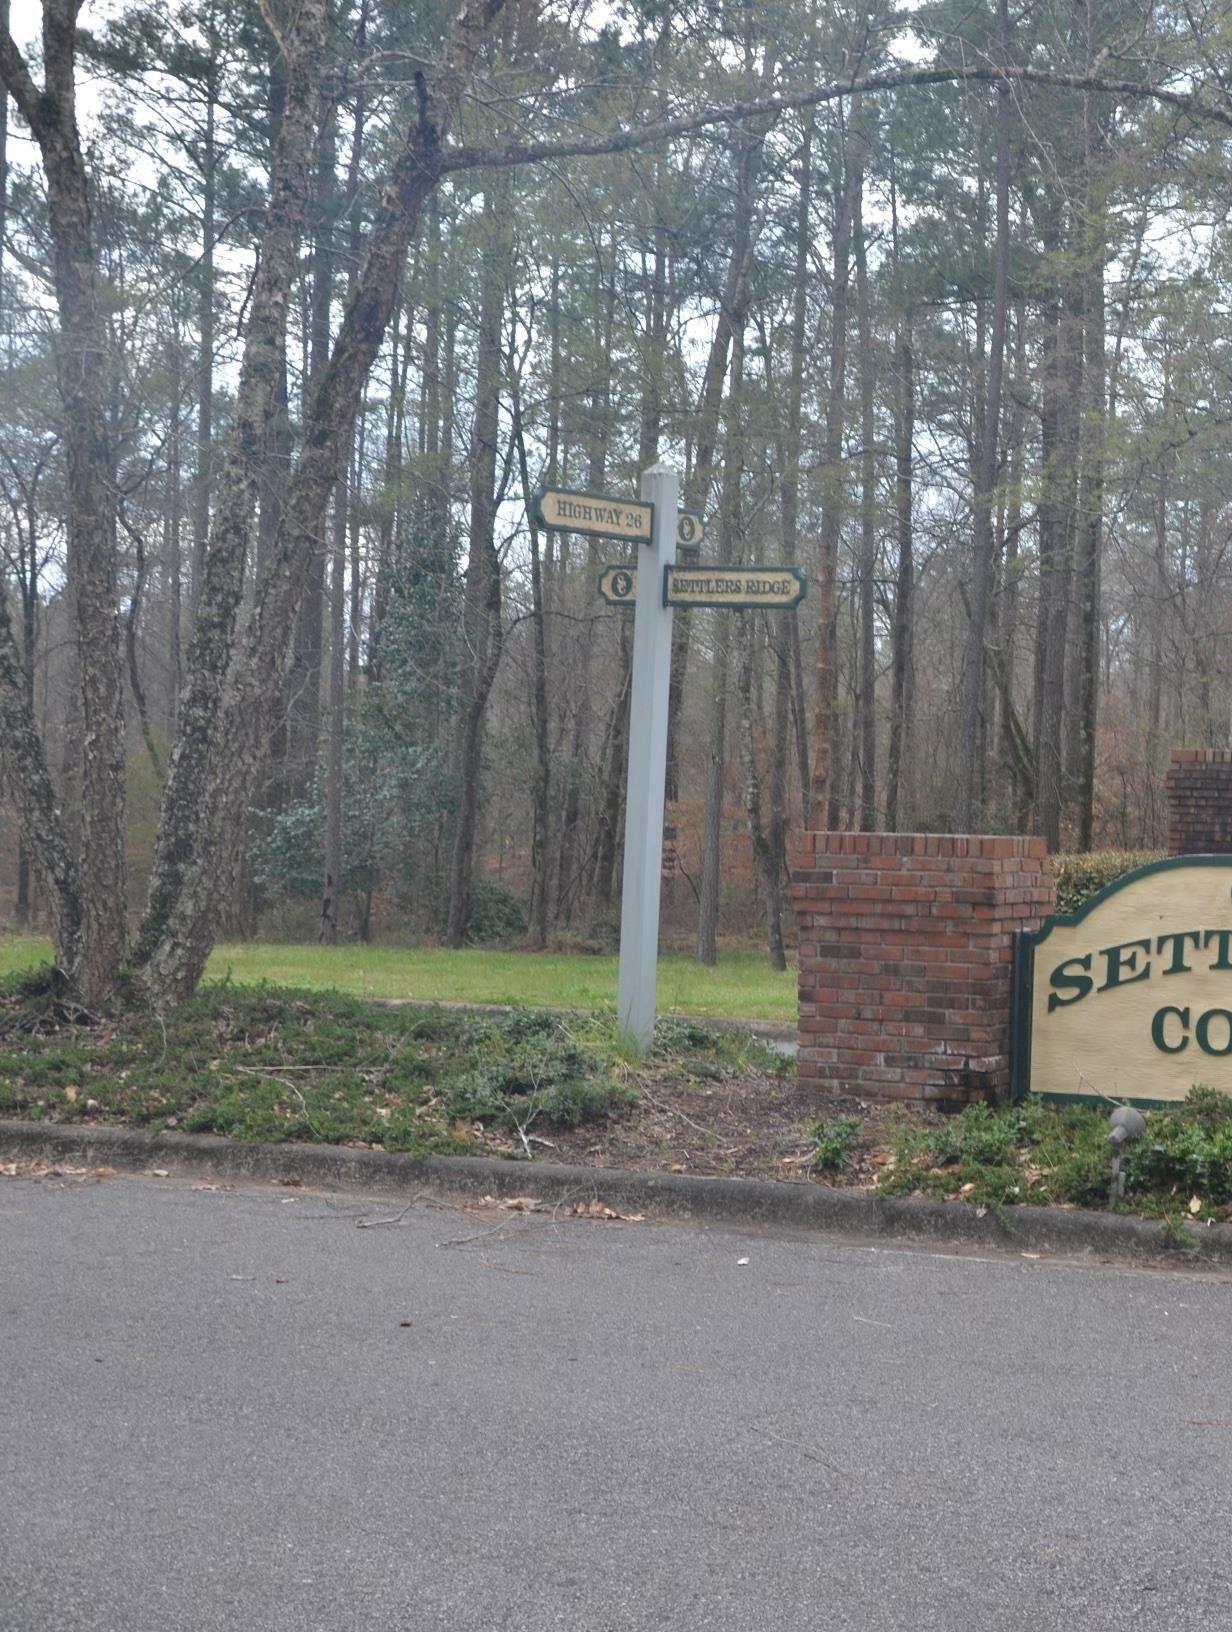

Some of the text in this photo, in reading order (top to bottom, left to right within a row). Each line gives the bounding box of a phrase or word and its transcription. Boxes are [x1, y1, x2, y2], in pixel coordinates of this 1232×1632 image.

[557, 500, 621, 526] HIGHWAY
[672, 578, 791, 595] SETTLERS RIDGE
